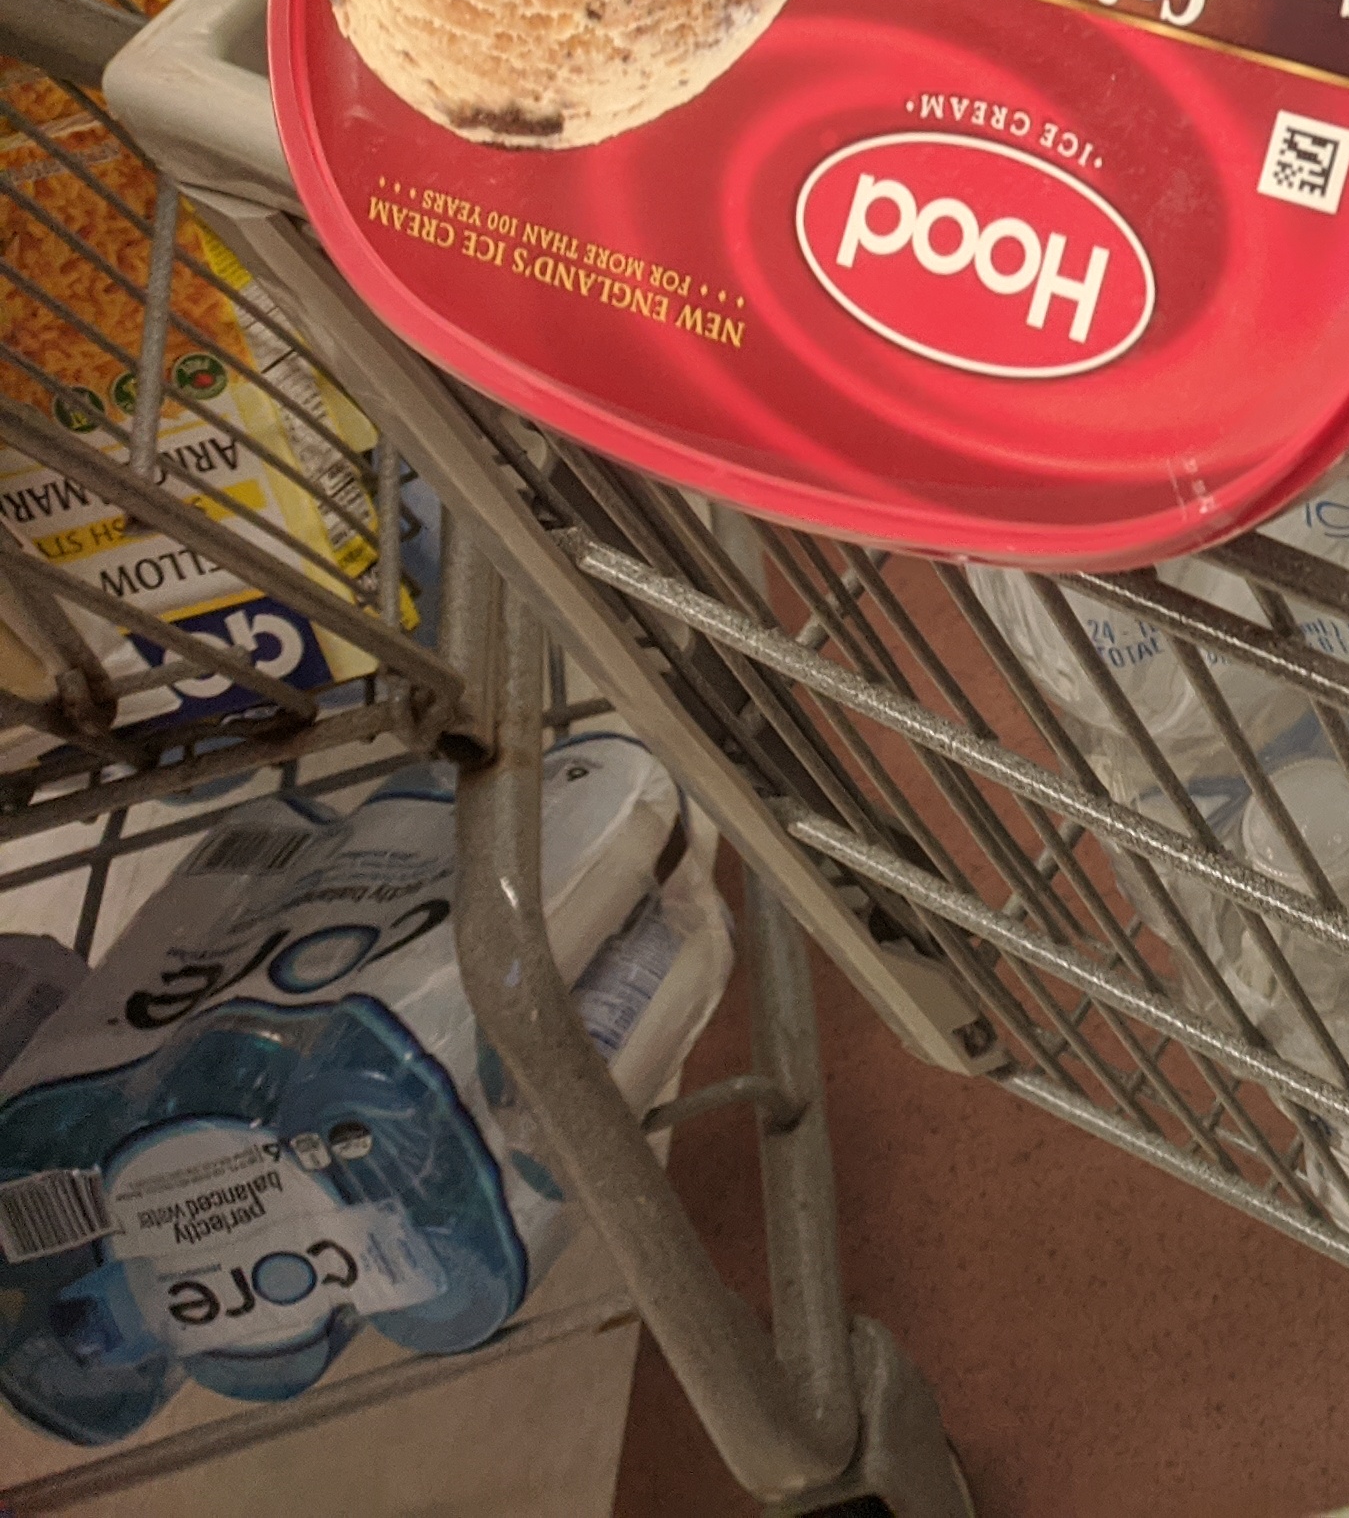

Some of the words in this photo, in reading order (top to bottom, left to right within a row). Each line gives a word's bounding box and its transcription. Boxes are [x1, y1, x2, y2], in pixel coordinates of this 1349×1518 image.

[916, 90, 1032, 137] CREAM
[1036, 122, 1096, 166] ICE
[363, 195, 458, 247] CREAM
[420, 188, 485, 224] YEARS
[484, 209, 519, 235] 100
[457, 228, 508, 266] ICE
[520, 221, 581, 257] THAN
[582, 242, 646, 280] MORE
[836, 172, 1112, 344] Hood
[507, 245, 672, 322] ENGLAND'S
[647, 263, 693, 296] FOR
[674, 301, 747, 347] NEW
[136, 1200, 180, 1232] water
[190, 1170, 284, 1219] balanced
[173, 1196, 267, 1245] perfectly
[168, 1238, 359, 1326] core
